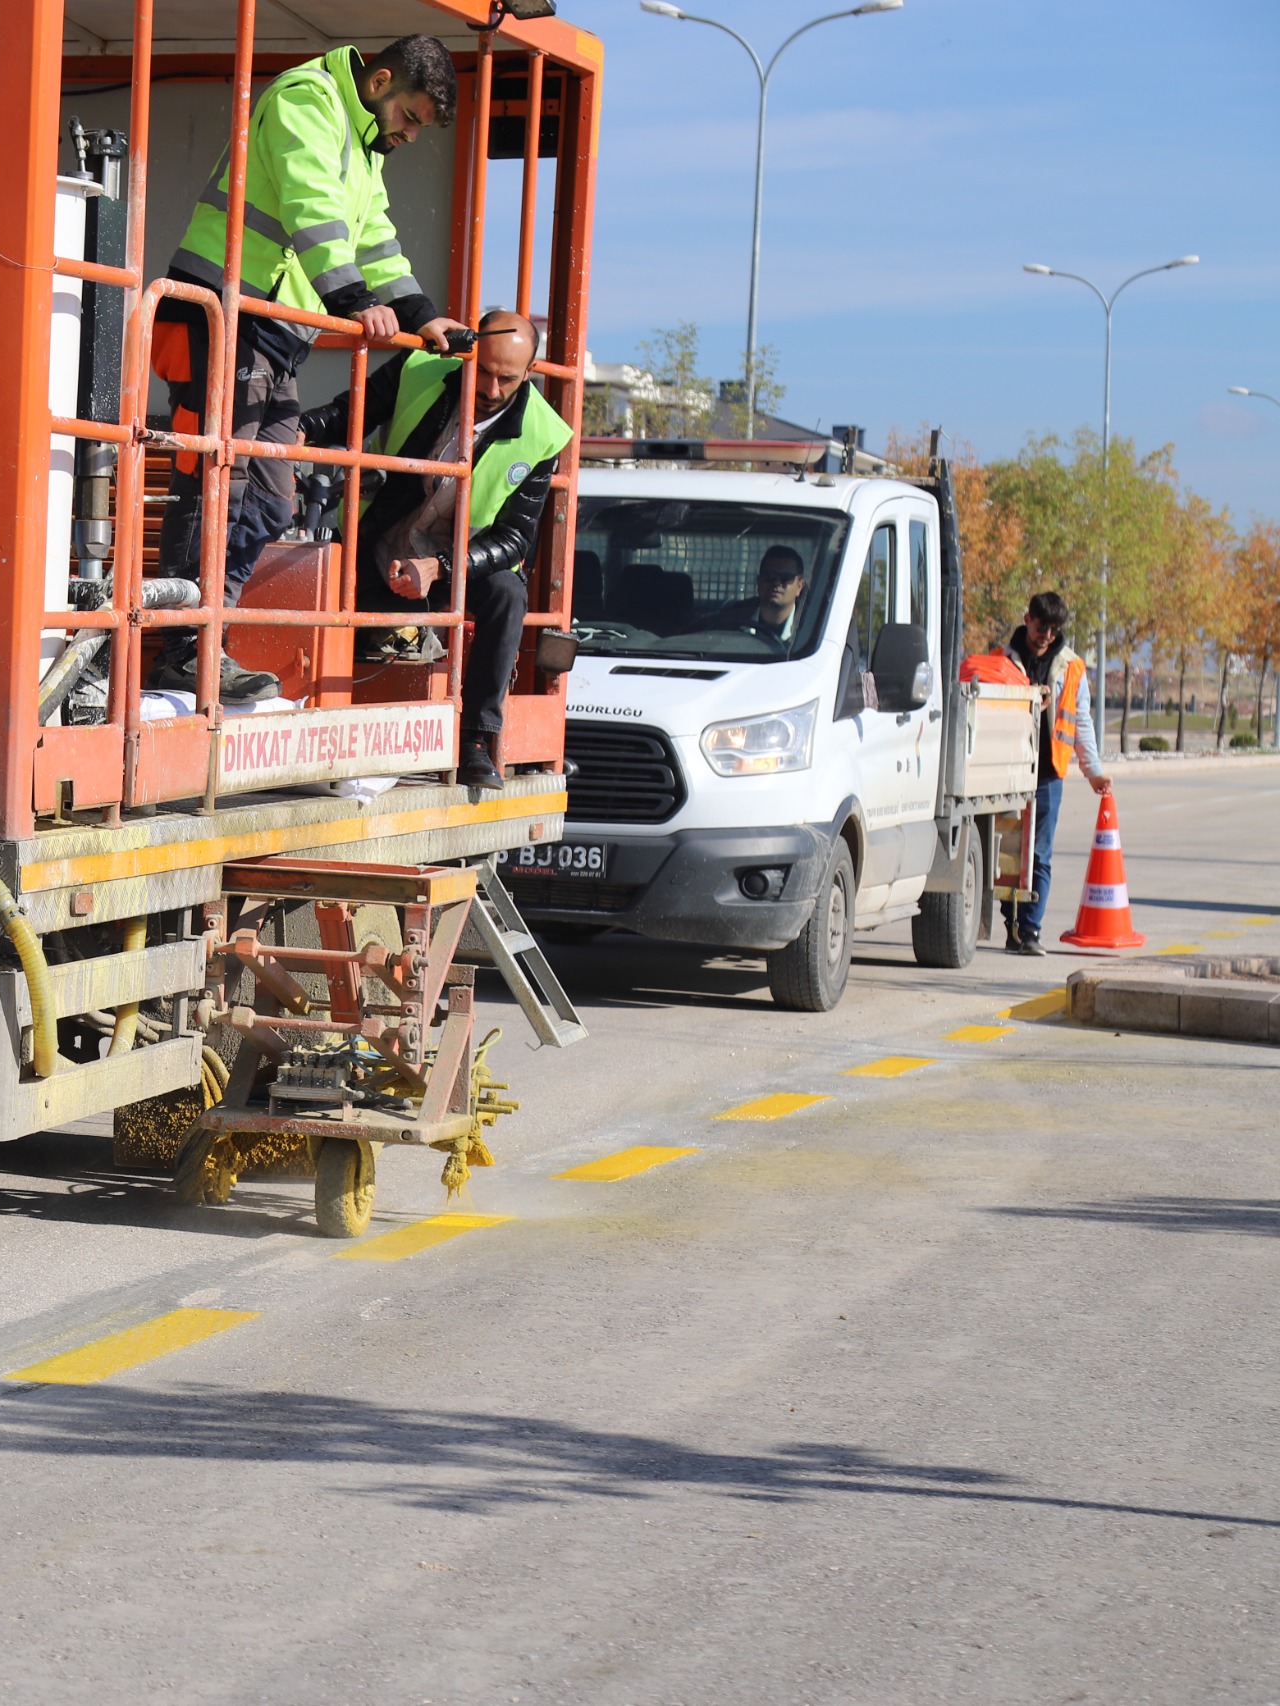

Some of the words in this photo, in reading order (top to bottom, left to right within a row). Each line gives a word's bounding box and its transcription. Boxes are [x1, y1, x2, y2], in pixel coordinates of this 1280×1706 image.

[223, 724, 292, 772] DİKKAT
[295, 723, 358, 769] ATEŞLE
[362, 719, 444, 762] YAKLAŞMA
[519, 845, 553, 866] BJ
[558, 845, 602, 869] 036
